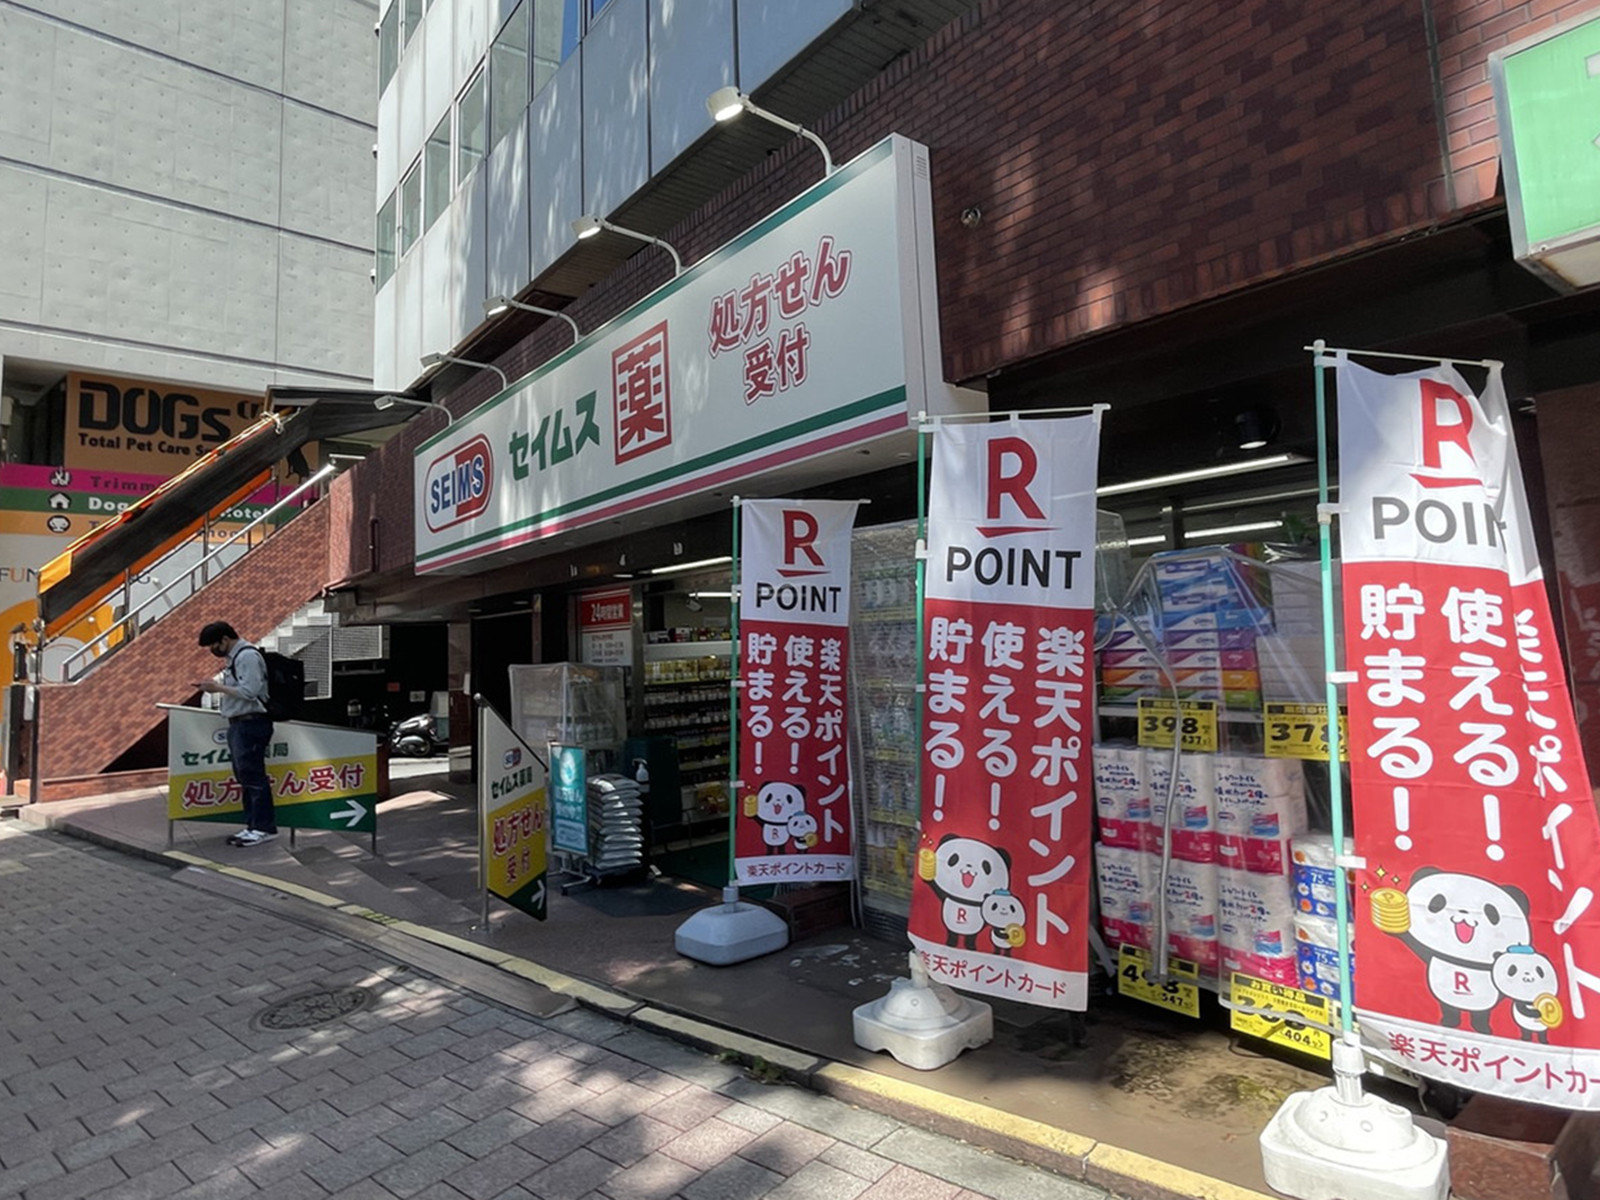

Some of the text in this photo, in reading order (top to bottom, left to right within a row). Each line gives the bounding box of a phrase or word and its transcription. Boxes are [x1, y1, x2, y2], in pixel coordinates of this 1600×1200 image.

[708, 234, 852, 358] 処方せん
[743, 322, 811, 404] 受付
[78, 380, 231, 443] DOGS
[508, 341, 664, 481] セイムス 薬
[1420, 378, 1481, 469] R
[78, 433, 121, 449] Total
[126, 437, 151, 452] Pet
[158, 441, 191, 456] Care
[90, 475, 160, 491] Trimm
[430, 454, 485, 516] SEIMS
[986, 436, 1047, 520] R
[781, 509, 825, 568] R
[945, 546, 1082, 589] POINT
[755, 582, 842, 613] POINT
[181, 742, 289, 766] セイム局
[814, 637, 845, 842] 楽天ポイント
[1143, 716, 1198, 734] 398
[1029, 626, 1087, 945] 楽天ポイント
[747, 862, 846, 877] 楽天ポイントカード
